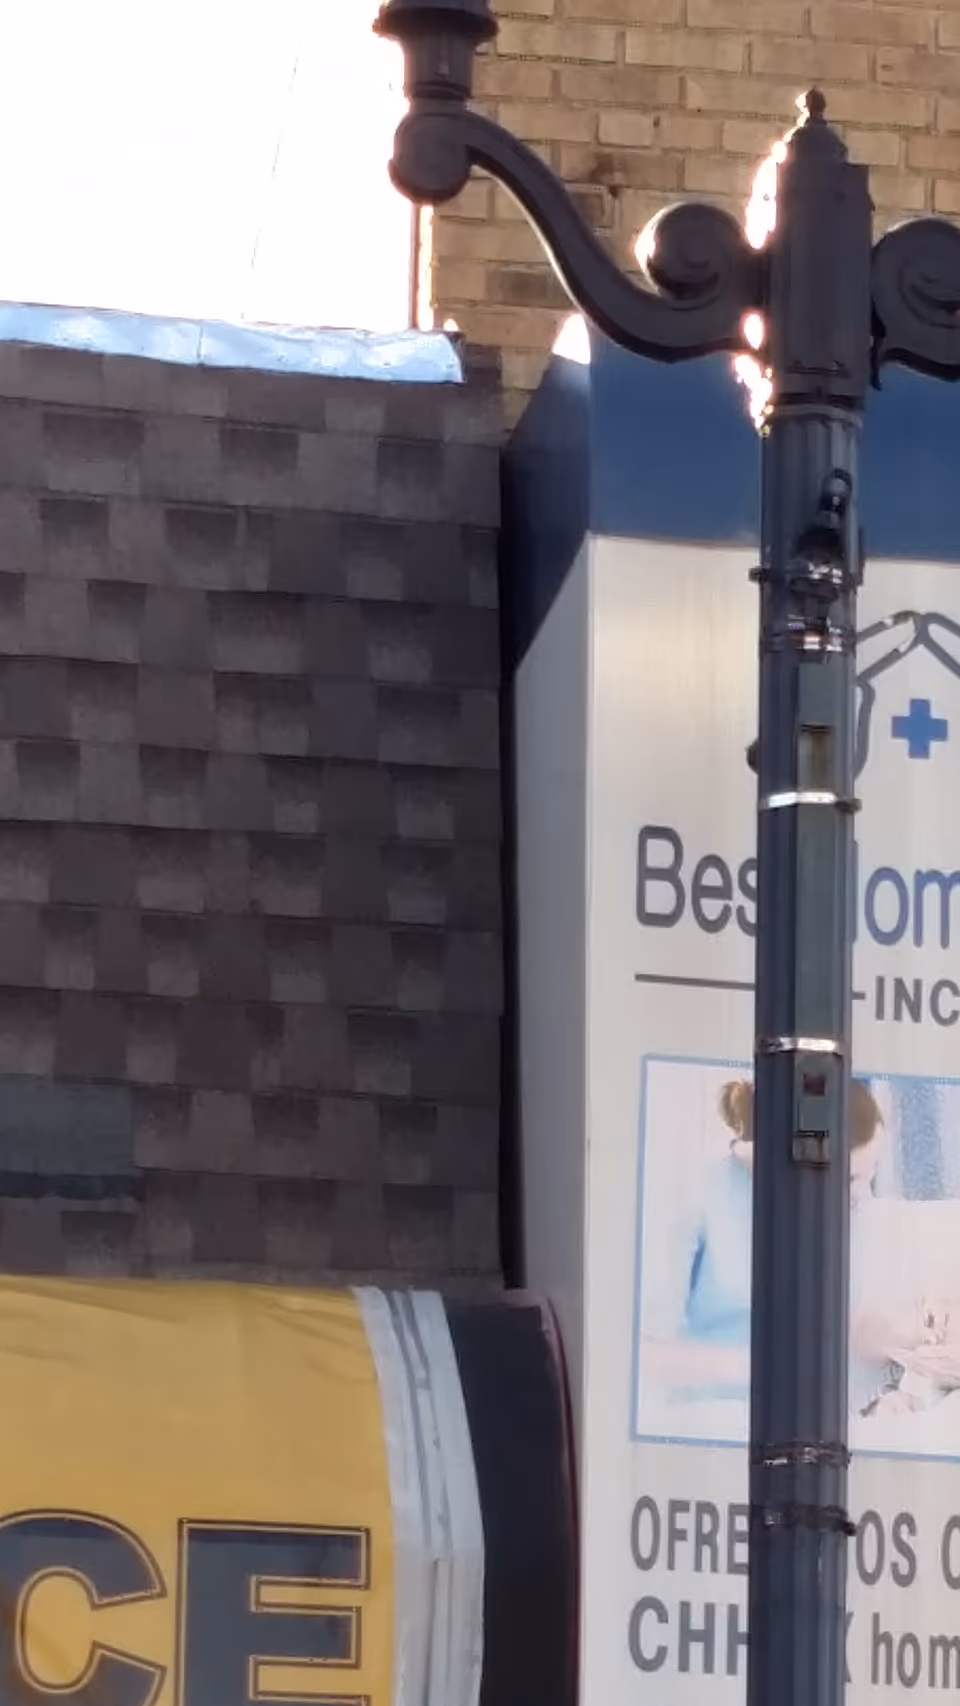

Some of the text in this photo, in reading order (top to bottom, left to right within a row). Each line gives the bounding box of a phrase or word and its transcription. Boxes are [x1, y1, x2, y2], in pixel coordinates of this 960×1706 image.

[874, 974, 960, 1027] INC
[630, 1496, 918, 1588] OFREOS
[628, 1596, 752, 1676] CHH
